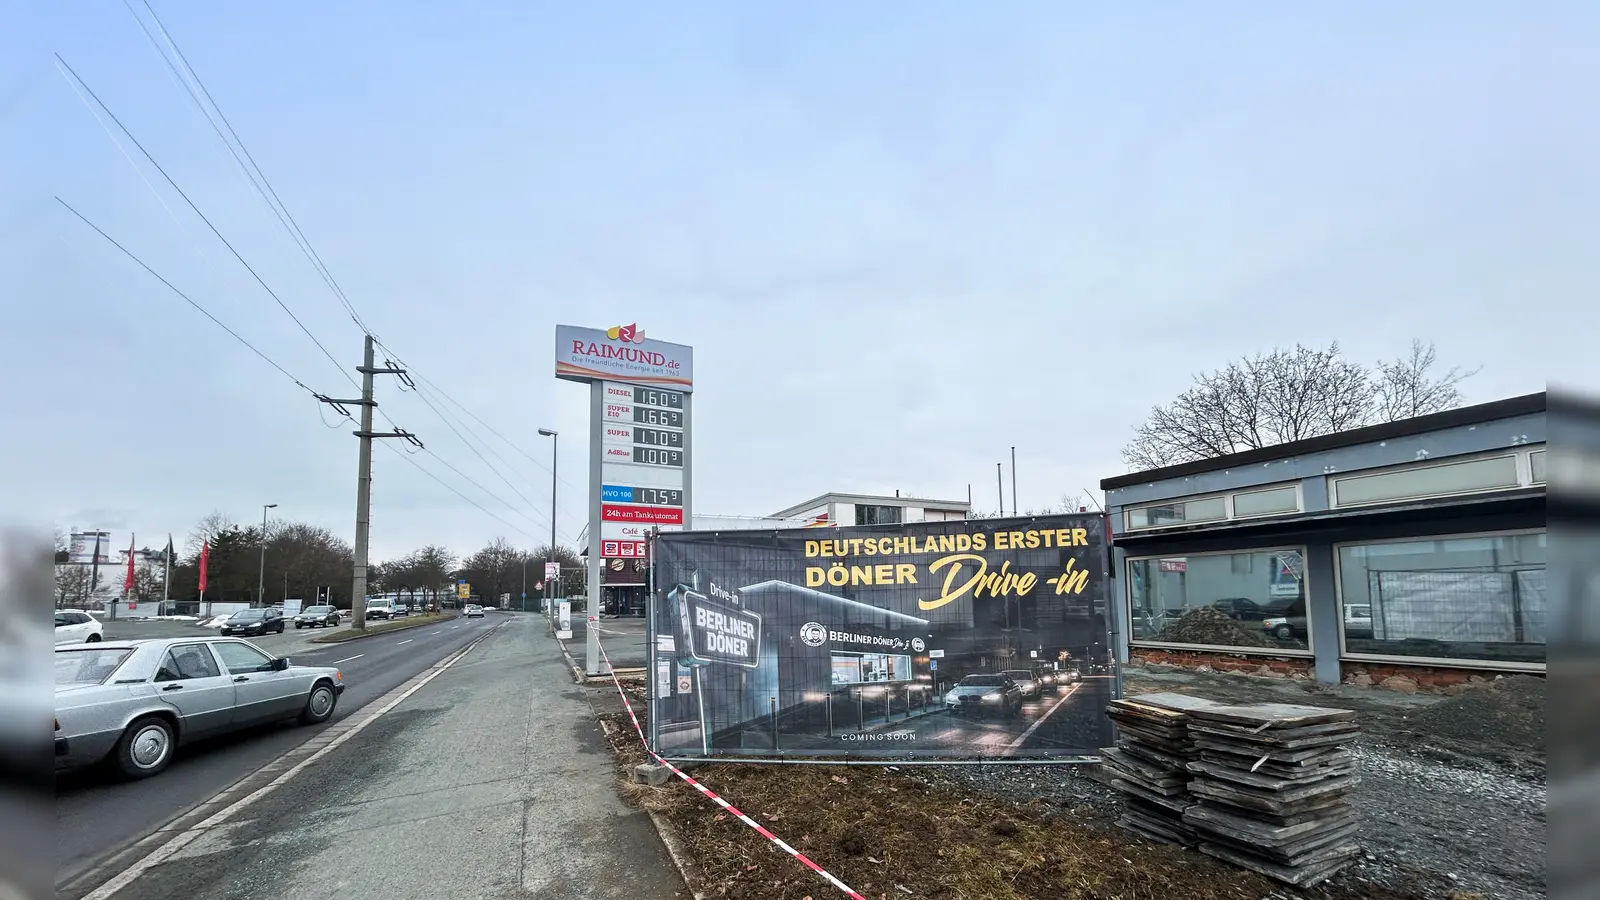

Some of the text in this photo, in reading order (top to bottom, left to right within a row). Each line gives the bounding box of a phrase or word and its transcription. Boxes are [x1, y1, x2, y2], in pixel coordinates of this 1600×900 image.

[572, 340, 680, 369] RAIMUND.de
[571, 355, 583, 363] Die
[585, 357, 624, 368] freundliche
[626, 363, 651, 373] Energie
[666, 369, 680, 377] 1963
[607, 387, 632, 397] DIESEL
[608, 429, 630, 437] SUPER
[607, 448, 630, 457] AdBlue
[606, 509, 621, 517] 24h
[622, 527, 639, 535] Café
[805, 528, 1088, 557] DEUTSCHLANDS ERSTER
[805, 561, 918, 587] DÖNER
[918, 553, 1038, 611] Drive
[709, 581, 739, 605] Drive-in
[695, 606, 755, 640] BERLINER
[706, 630, 749, 657] DÖNER
[829, 630, 872, 645] BERLINER
[872, 635, 894, 647] DÖNER
[841, 733, 916, 741] COMING SOON
